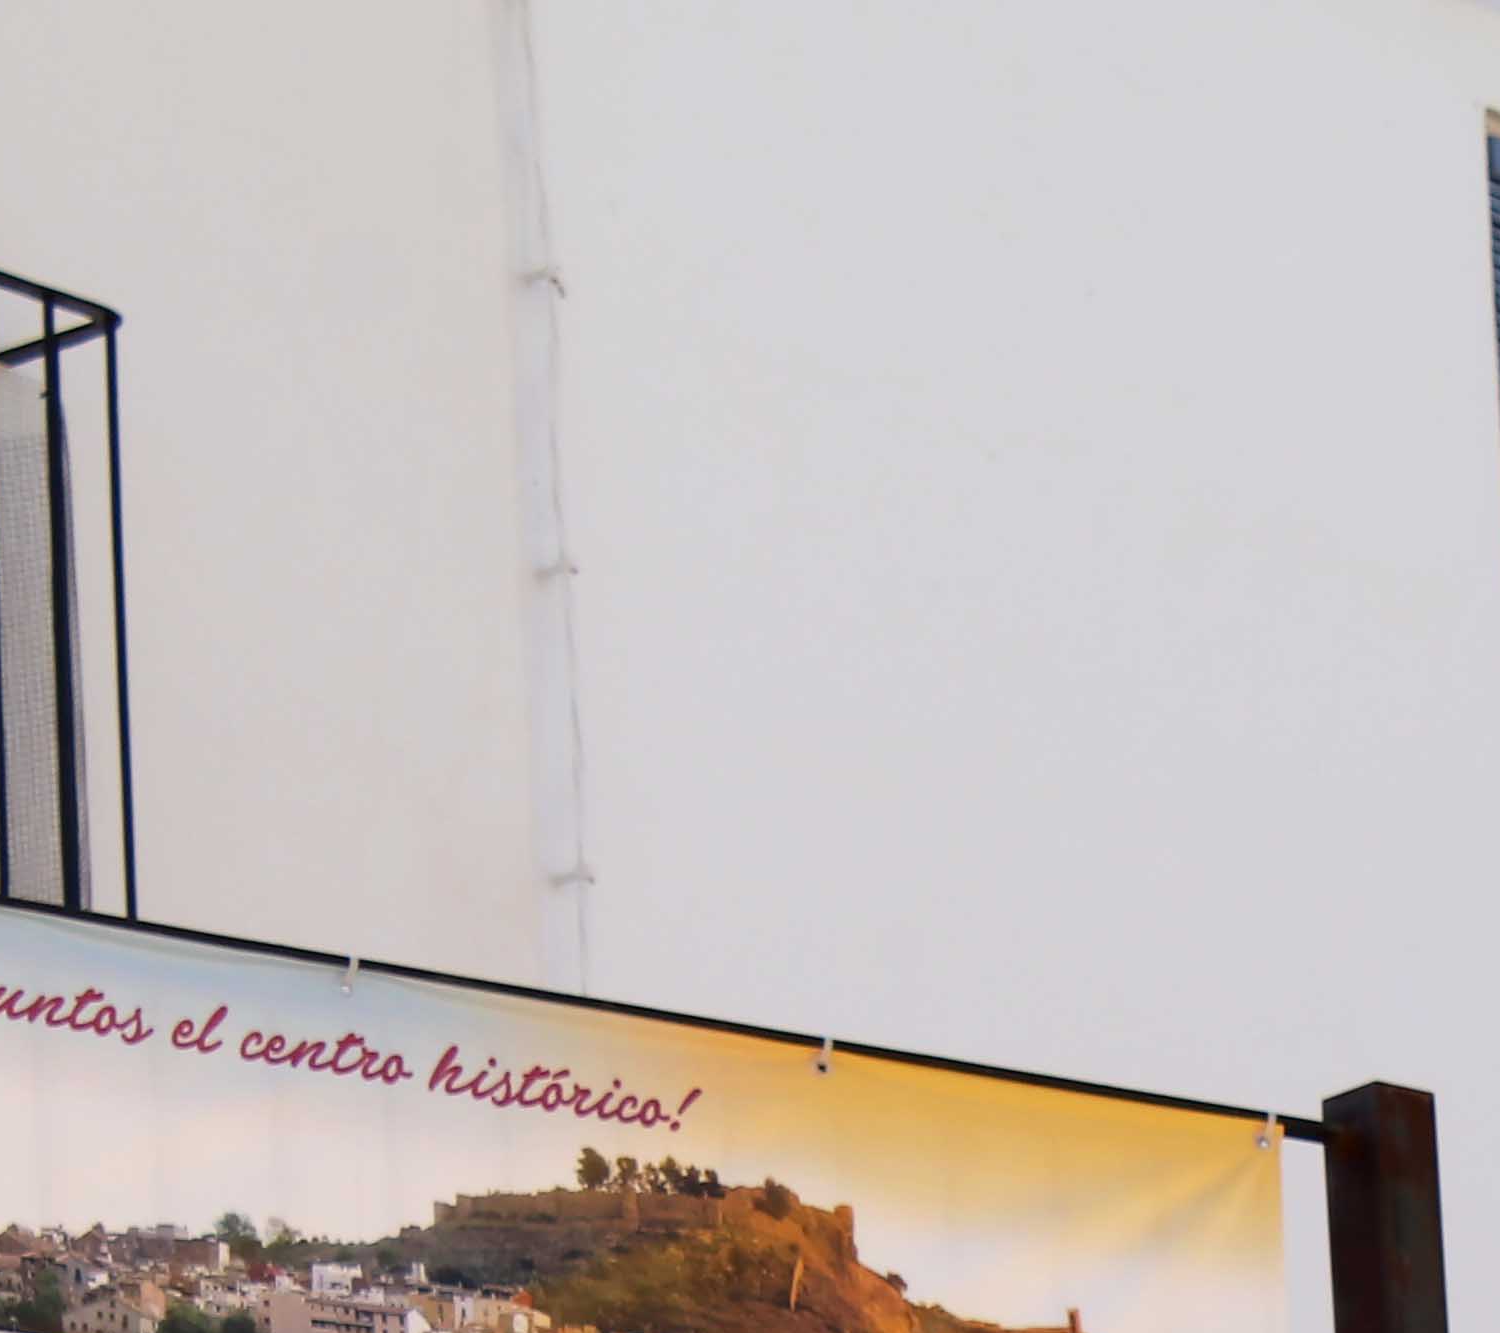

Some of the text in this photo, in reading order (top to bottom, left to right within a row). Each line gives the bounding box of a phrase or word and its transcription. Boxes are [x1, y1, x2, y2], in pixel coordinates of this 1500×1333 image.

[171, 1003, 229, 1054] el
[240, 1032, 414, 1084] centro
[428, 1045, 703, 1132] histórico!
